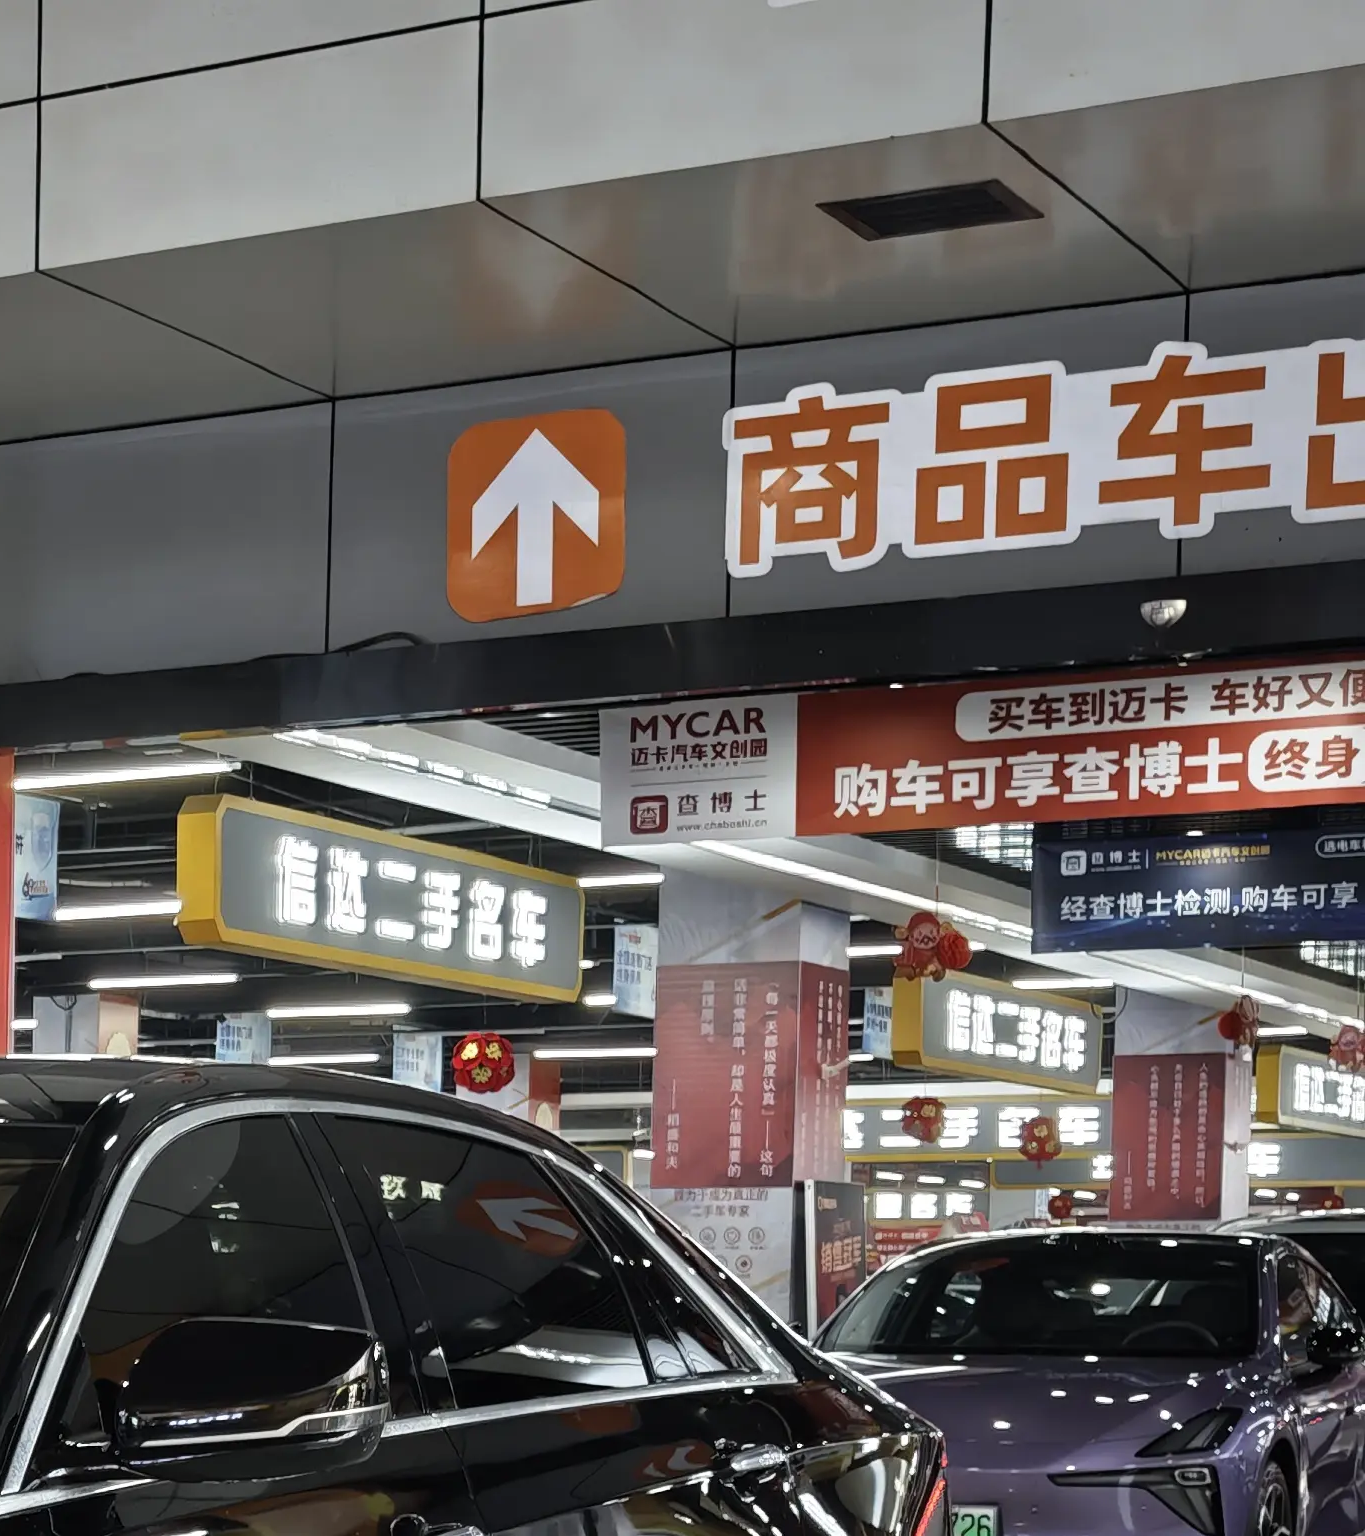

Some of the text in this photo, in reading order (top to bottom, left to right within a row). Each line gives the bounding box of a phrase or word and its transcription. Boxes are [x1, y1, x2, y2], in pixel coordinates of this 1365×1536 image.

[987, 668, 1365, 734] 买车到迈卡 车好又便
[630, 707, 767, 743] MYCAR
[631, 738, 768, 766] 迈卡汽车文创园
[833, 734, 1361, 818] 购车可享查博士 终身
[676, 789, 767, 816] 查博士
[275, 834, 549, 969] 信达二手名车
[1060, 880, 1359, 922] 经查博士检测,购车可享
